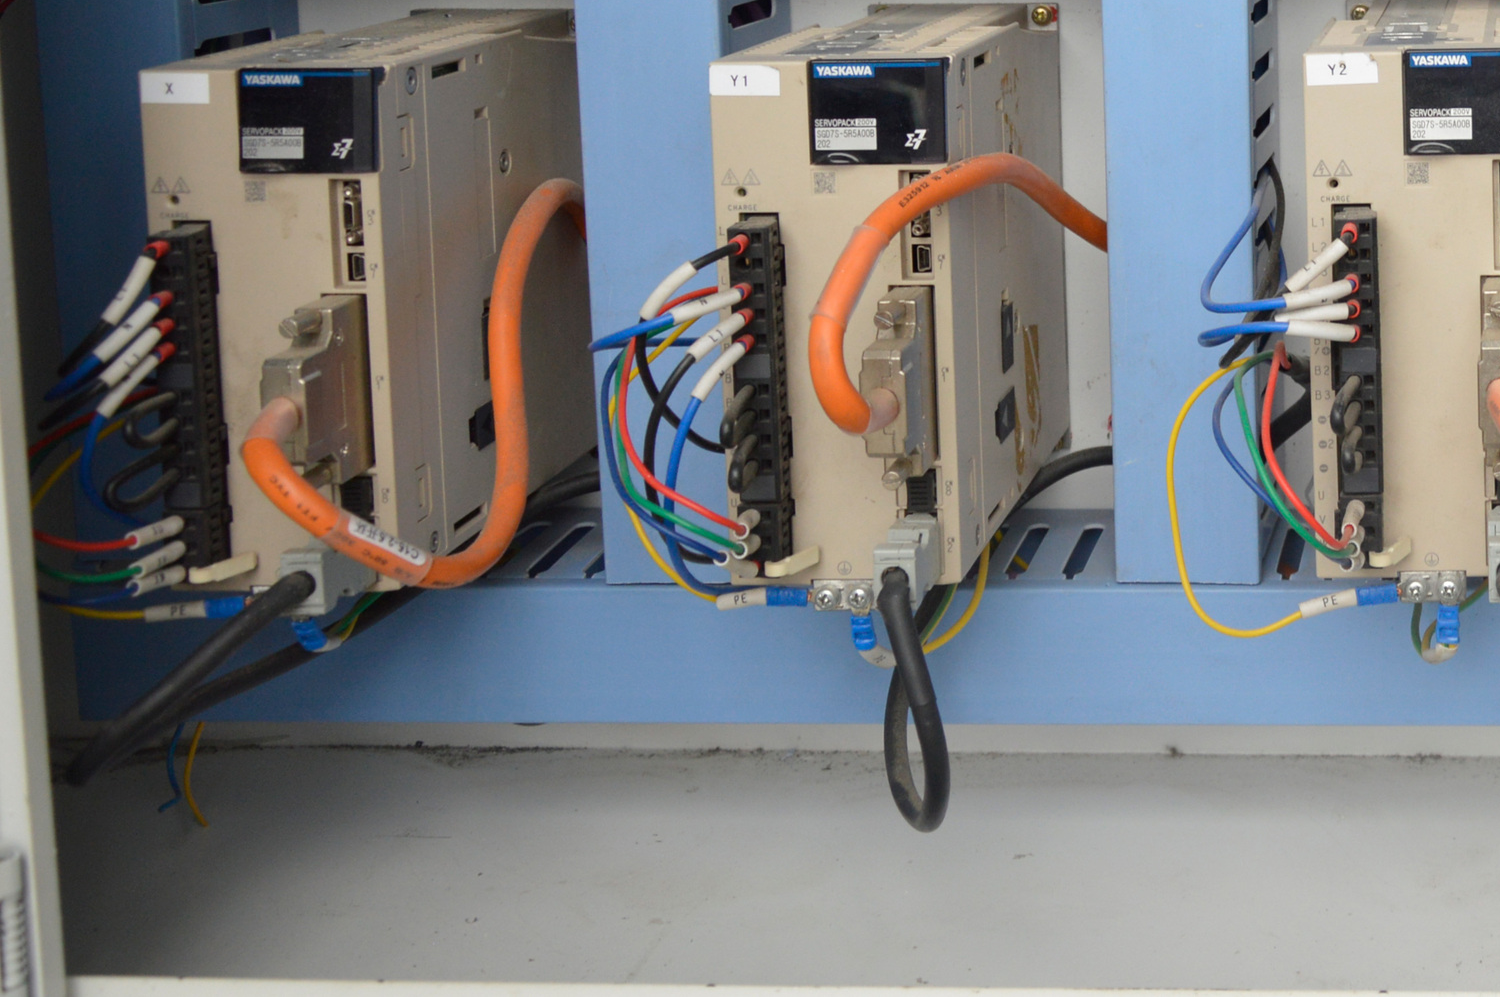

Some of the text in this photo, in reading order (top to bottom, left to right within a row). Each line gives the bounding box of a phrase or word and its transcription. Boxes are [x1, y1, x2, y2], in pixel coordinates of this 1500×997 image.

[1411, 55, 1469, 66] YASKAWA
[816, 65, 873, 77] YASKAWA
[1328, 64, 1347, 76] Y2
[244, 74, 301, 85] YASKAWA
[731, 75, 748, 87] Y1
[165, 82, 174, 94] X
[1409, 108, 1451, 117] SERVOPACK
[814, 119, 856, 127] SERVOPACK
[242, 127, 283, 136] SERVOPACK
[1412, 129, 1426, 139] 202
[817, 139, 831, 148] 202
[899, 182, 930, 208] E325912
[727, 204, 758, 212] CHARGE
[1311, 218, 1325, 227] L1
[709, 328, 724, 344] L1
[1315, 366, 1330, 375] B2
[1315, 391, 1330, 400] B3
[1318, 491, 1324, 500] U
[1319, 515, 1326, 524] V
[733, 593, 748, 605] PE
[1322, 596, 1338, 607] PE
[170, 606, 186, 615] PE
